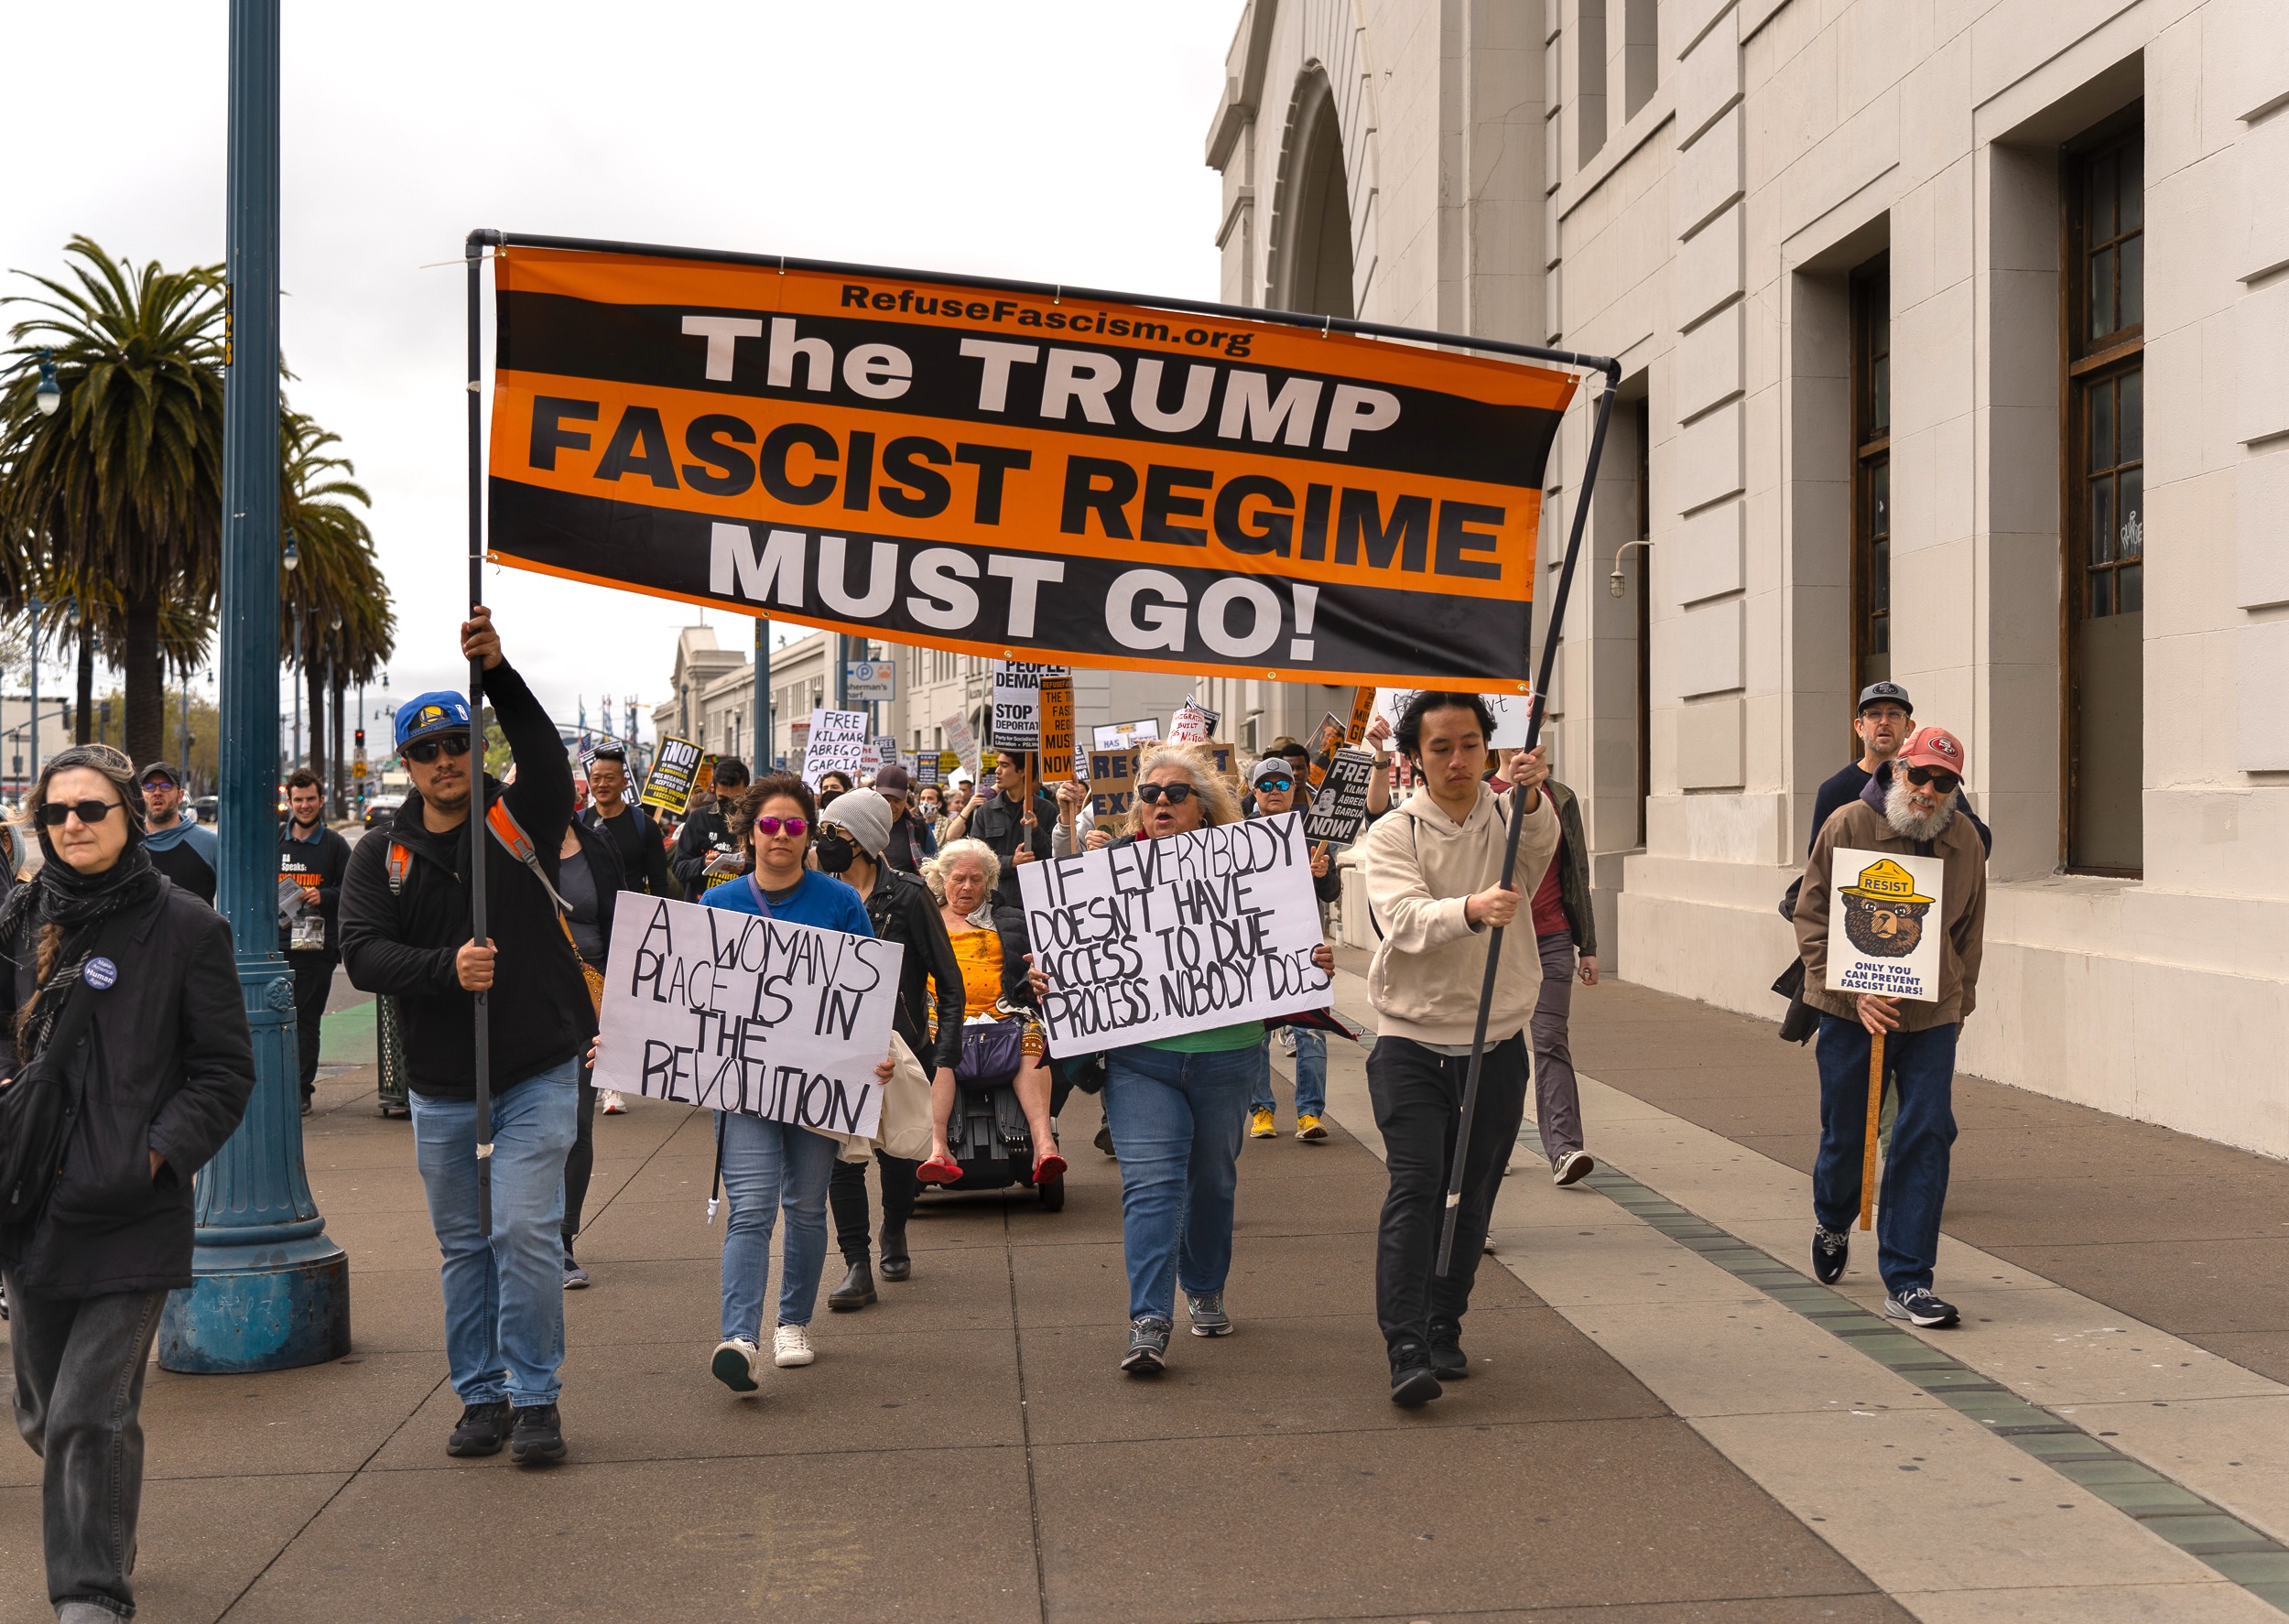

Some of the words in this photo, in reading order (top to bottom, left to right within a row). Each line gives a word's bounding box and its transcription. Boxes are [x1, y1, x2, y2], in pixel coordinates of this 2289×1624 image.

[841, 285, 1254, 357] RefuseFascism.org
[681, 316, 913, 400] The
[959, 338, 1401, 452] TRUMP
[528, 395, 1032, 525] FASCIST
[1059, 455, 1505, 580] REGIME
[709, 522, 1065, 638] MUST
[1104, 568, 1319, 661] GO!
[996, 672, 1058, 688] DEMA
[1046, 691, 1062, 703] THE
[996, 703, 1032, 720] STOP
[824, 712, 860, 729] FREE
[815, 731, 863, 742] KILMAR
[1103, 740, 1120, 749] HAS
[661, 741, 699, 769] ¡NO!
[808, 744, 861, 756] ABREGO
[1343, 784, 1368, 796] KILMA
[1338, 795, 1366, 807] ABREG
[1335, 806, 1363, 818] GARCIA
[1307, 816, 1355, 839] NOW!
[281, 862, 308, 872] Speaks:
[1042, 851, 1084, 908] IF
[1107, 812, 1296, 895] EVERYBODY
[1864, 879, 1908, 893] RESIST
[1031, 887, 1154, 954] DOESN'T
[1172, 868, 1262, 926] HAVE
[638, 899, 673, 957] A
[707, 907, 883, 992] WOMAN'S
[1042, 934, 1143, 991] ACCESS
[1156, 926, 1199, 970] TO
[1210, 910, 1278, 962] DUE
[92, 964, 114, 976] America
[97, 959, 113, 969] Make
[1855, 962, 1884, 972] ONLY
[1888, 965, 1911, 976] YOU
[86, 968, 114, 984] Human
[90, 978, 105, 988] Again
[1159, 956, 1257, 1019] NOBODY
[1264, 943, 1330, 1001] DOES
[1845, 969, 1868, 980] CAN
[1871, 973, 1921, 986] PREVENT
[632, 948, 728, 1014] PLACE
[753, 972, 793, 1023] IS
[815, 986, 863, 1041] IN
[1841, 979, 1884, 991] FASCIST
[1887, 985, 1923, 995] LIARS!
[689, 1007, 774, 1065] THE
[641, 1039, 870, 1134] REVOLUTION
